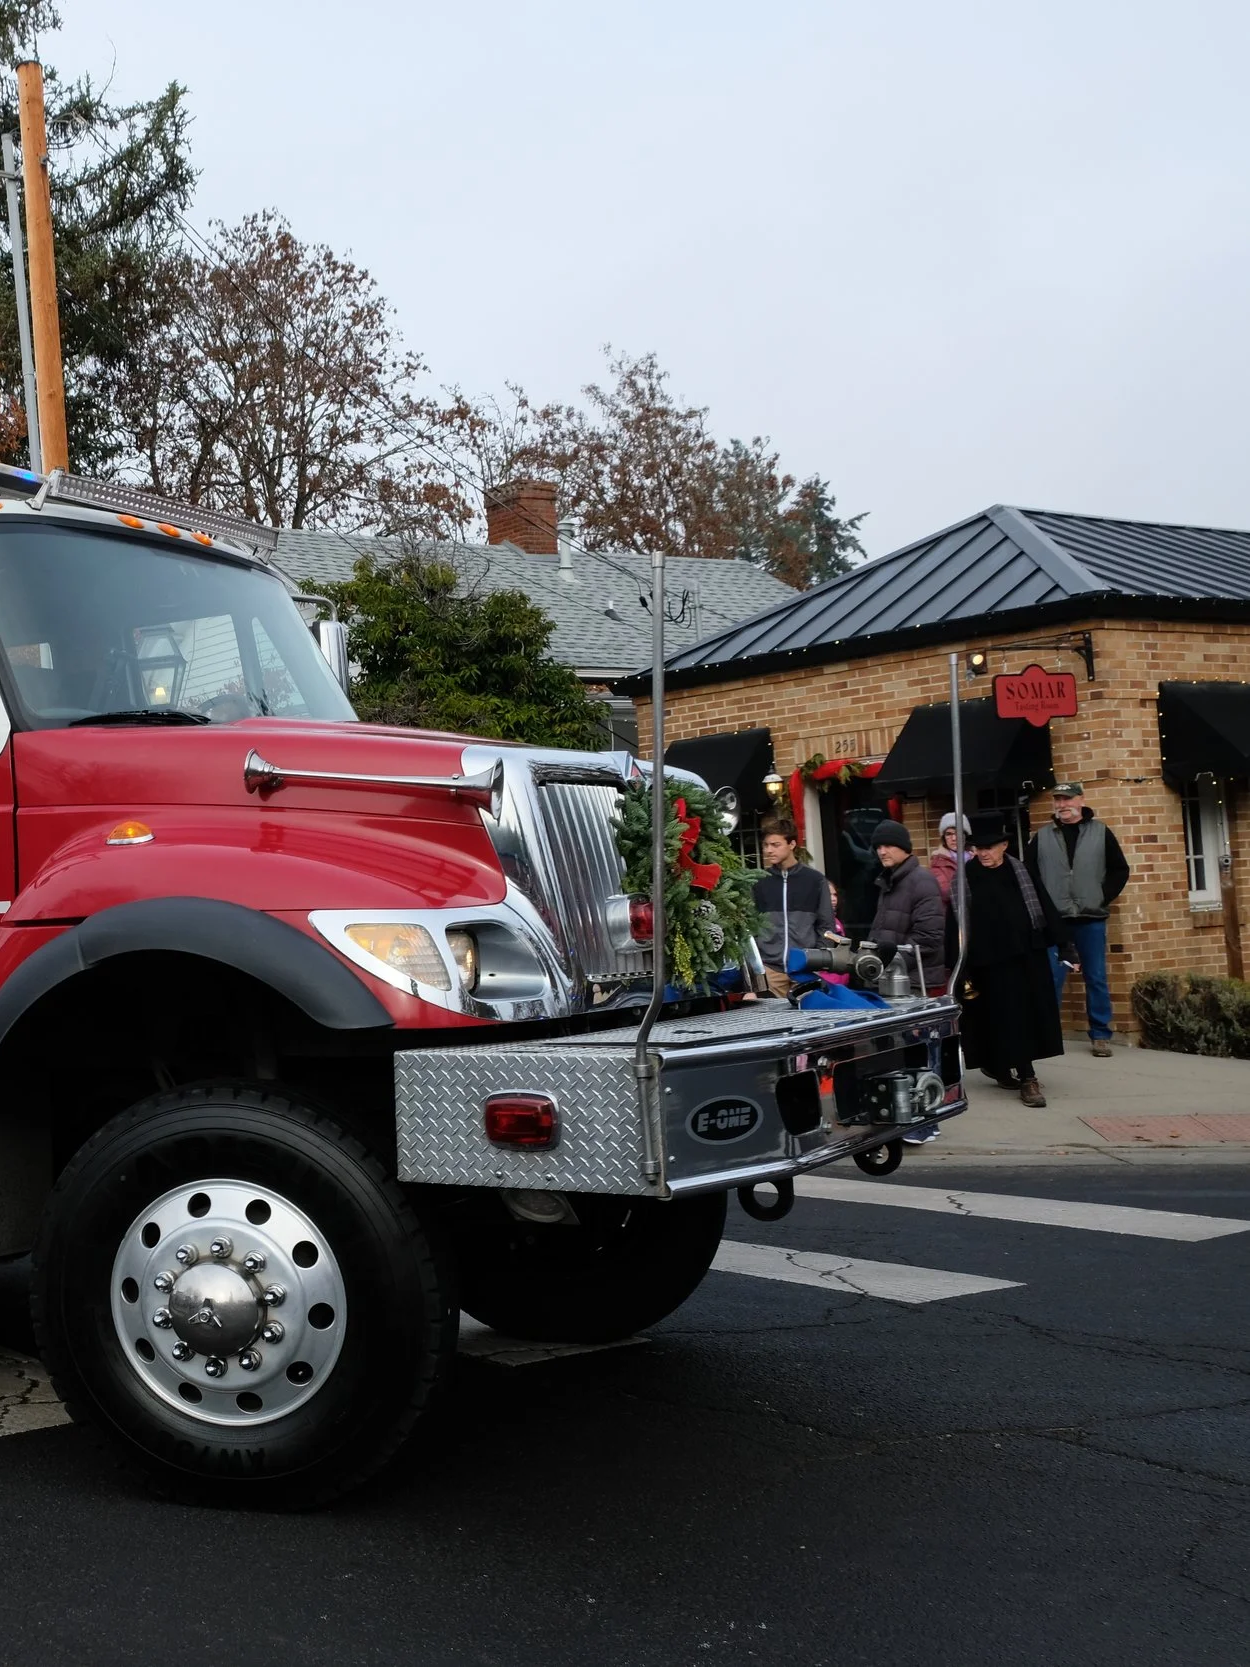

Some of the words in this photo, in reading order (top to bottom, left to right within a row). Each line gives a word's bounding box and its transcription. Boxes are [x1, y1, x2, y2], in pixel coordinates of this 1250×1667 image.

[1006, 682, 1066, 699] SOMAR
[835, 738, 856, 753] 255
[697, 1106, 752, 1133] E-ONE
